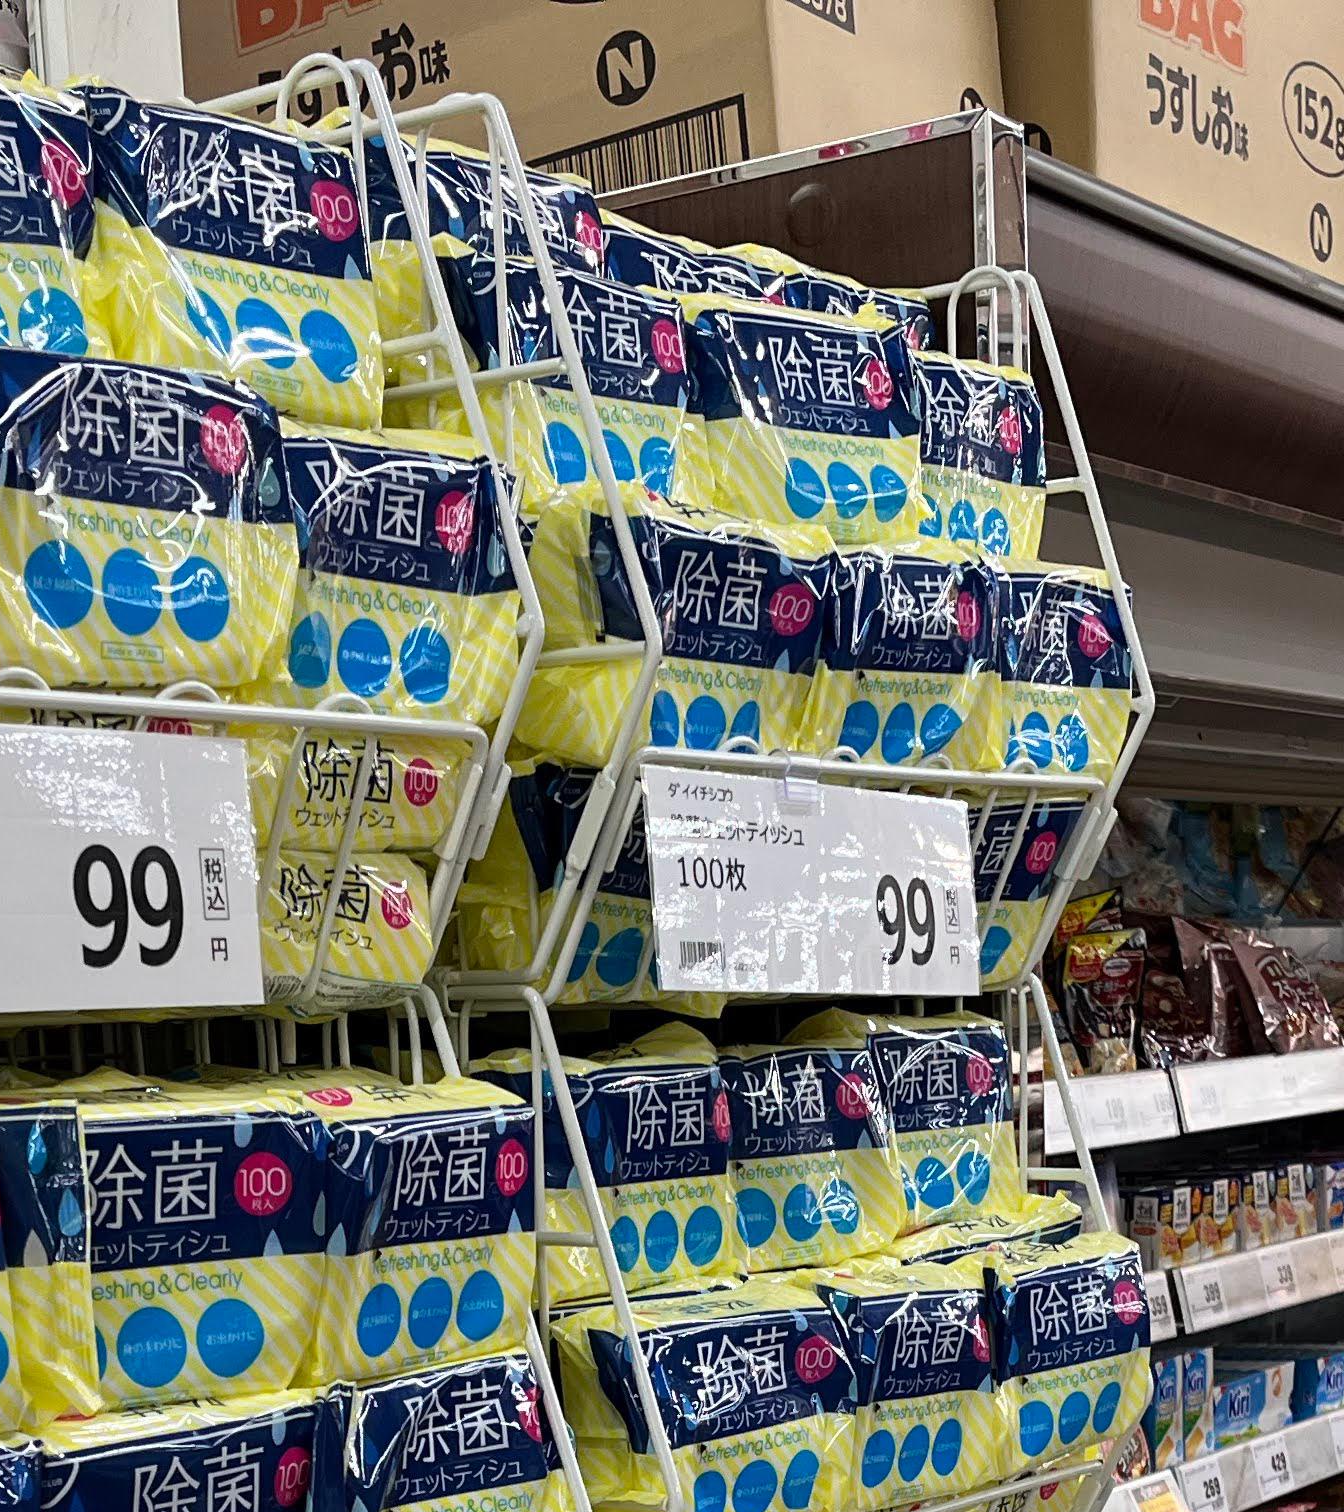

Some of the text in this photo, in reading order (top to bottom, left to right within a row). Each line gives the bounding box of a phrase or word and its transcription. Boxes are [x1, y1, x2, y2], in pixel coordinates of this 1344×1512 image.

[606, 40, 648, 94] N
[1146, 53, 1249, 161] うすしお味
[312, 190, 354, 224] 100
[770, 334, 856, 408] 除菌
[55, 363, 186, 469] 除菌
[670, 548, 763, 631] 除菌
[770, 594, 813, 622] 100
[661, 629, 764, 664] ウェットティシュ
[407, 769, 437, 794] 100
[1027, 841, 1056, 864] 100
[203, 855, 227, 912] 税込
[677, 855, 748, 893] 100枚
[72, 844, 184, 969] 99
[875, 873, 936, 966] 99
[209, 936, 229, 963] 円
[626, 1081, 707, 1154] 除菌
[238, 1165, 287, 1198] 100
[393, 1126, 491, 1211] 除菌
[497, 1151, 527, 1180] 100
[617, 1153, 711, 1182] ウェットティシュ
[88, 1138, 224, 1230] 除菌
[250, 1198, 276, 1213] 枚入
[384, 1207, 491, 1242] ウェットティシュ
[1030, 1273, 1109, 1347] 除菌
[894, 1307, 966, 1371] 除菌
[1026, 1338, 1116, 1371] ウェットティシュ
[796, 1346, 835, 1370] 100
[883, 1367, 961, 1396] ウェットティシュ
[1187, 1370, 1204, 1393] Kiri
[1325, 1364, 1344, 1390] Kiri
[1229, 1384, 1251, 1419] Kiri
[403, 1381, 512, 1466] 除菌
[394, 1457, 525, 1502] ウェットティシュ
[1203, 1476, 1221, 1499] 269
